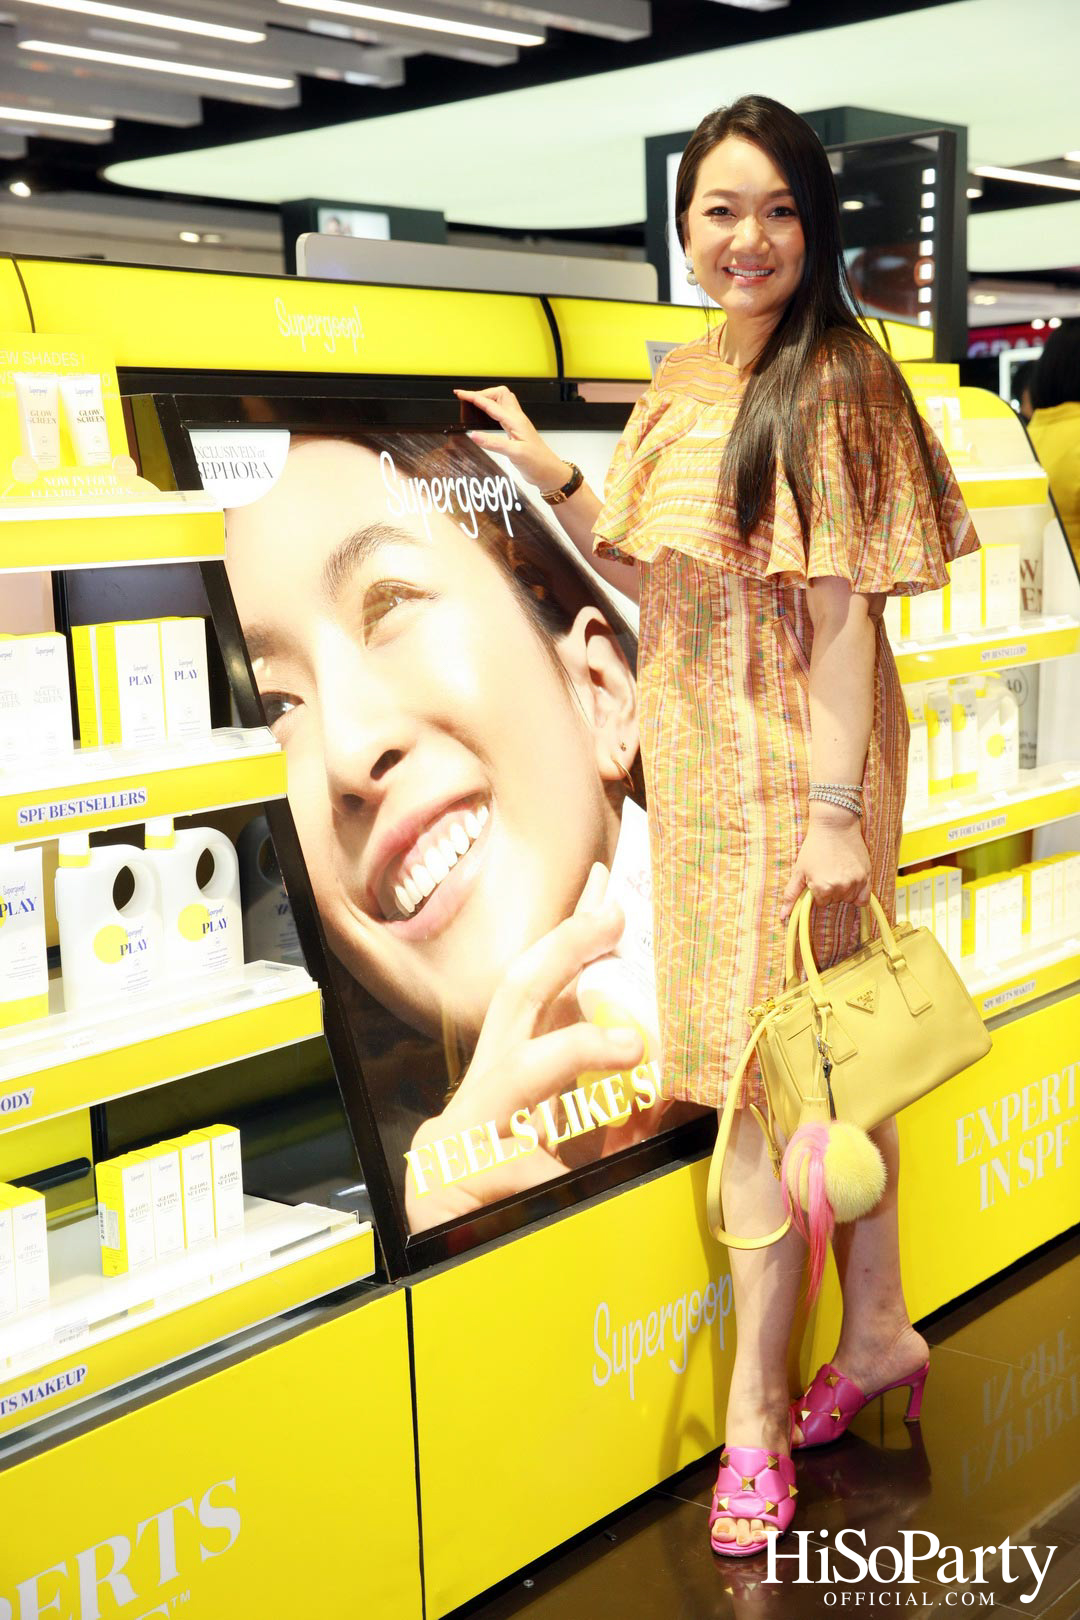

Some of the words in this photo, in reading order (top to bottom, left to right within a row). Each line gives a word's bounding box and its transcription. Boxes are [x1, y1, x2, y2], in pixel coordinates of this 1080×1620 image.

[273, 296, 366, 354] Supergoop!
[193, 445, 257, 459] XCLUSIVELY
[379, 450, 522, 544] Supergoop!
[128, 675, 153, 687] PLAY
[174, 669, 199, 681] PLAY
[19, 806, 47, 825] SPF
[49, 790, 147, 820] BESTSELLERS
[0, 896, 38, 919] PLAY
[202, 915, 229, 935] PLAY
[120, 937, 149, 957] PLAY
[403, 1106, 540, 1199] FEELS
[536, 1072, 633, 1148] LIKE
[979, 1149, 1011, 1213] IN
[21, 1367, 87, 1408] MAKEUP
[0, 1476, 243, 1620] ERTS
